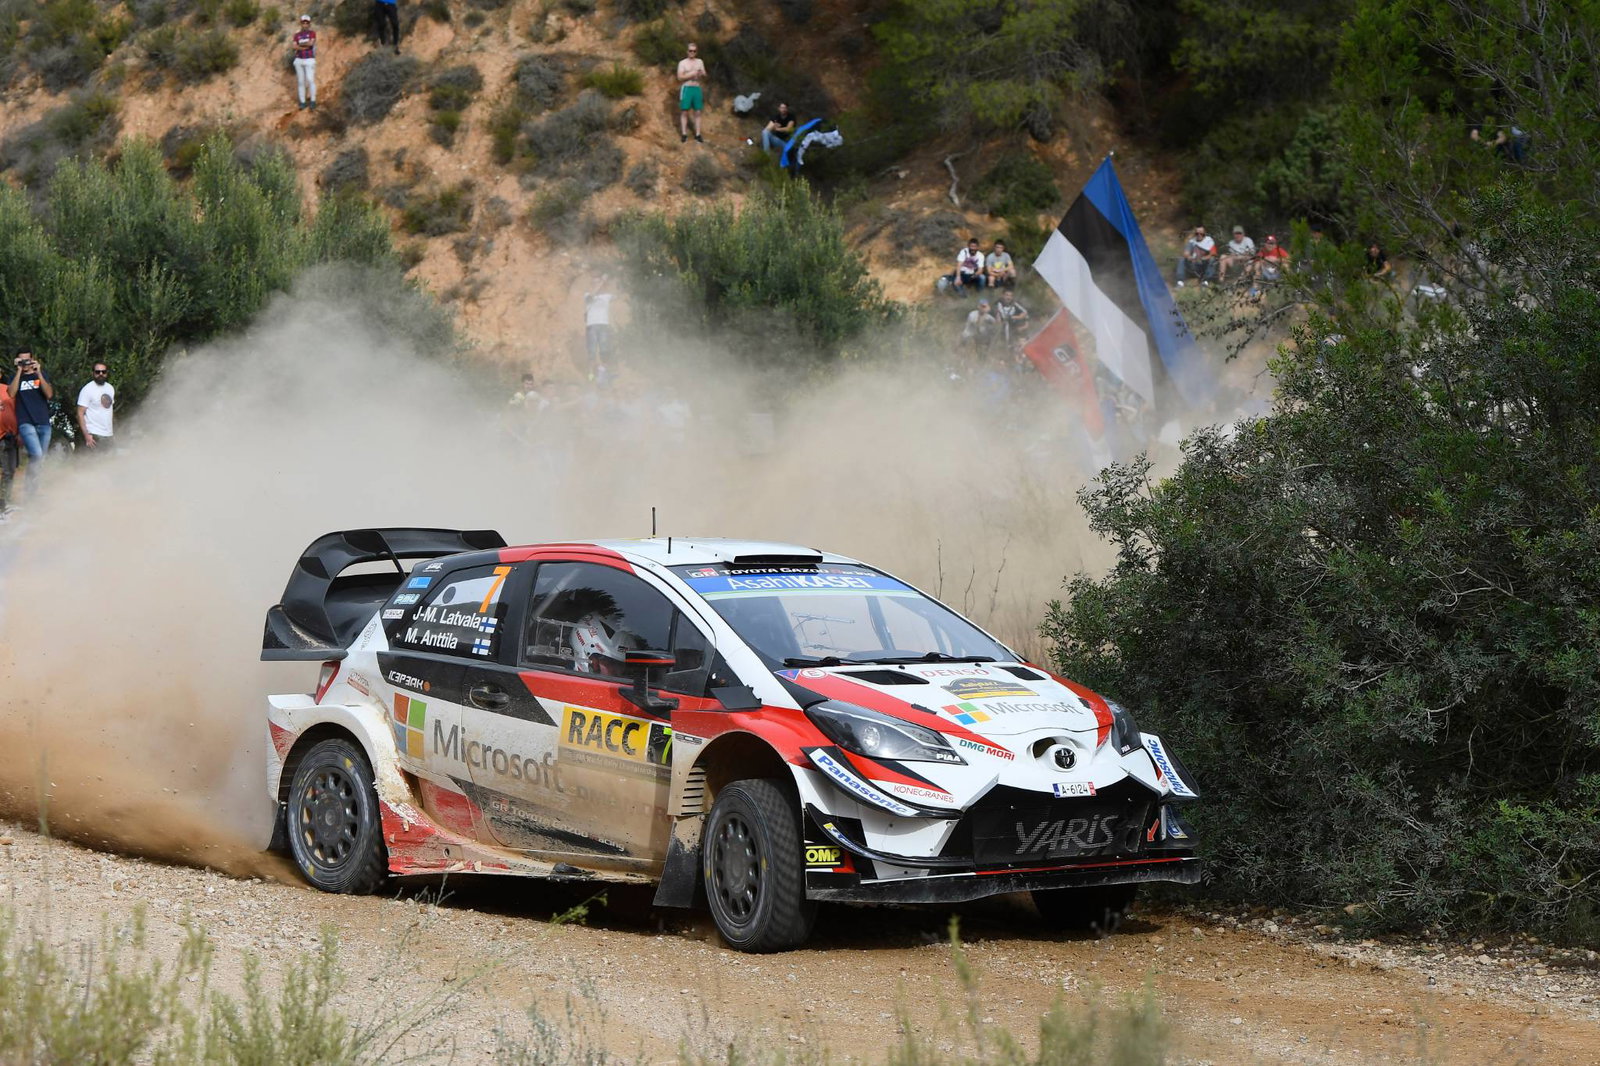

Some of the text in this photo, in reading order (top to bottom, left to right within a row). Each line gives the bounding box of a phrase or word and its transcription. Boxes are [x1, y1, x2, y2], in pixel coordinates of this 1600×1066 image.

[479, 566, 512, 613] 7
[412, 605, 437, 623] J-M.
[439, 608, 480, 629] Latvala
[404, 627, 458, 650] M. Anttila
[919, 669, 991, 678] DENSO
[982, 701, 1085, 716] Microsoft
[567, 710, 641, 756] RACC
[433, 718, 565, 793] Microsoft
[936, 753, 962, 763] PIAA
[958, 739, 1017, 761] DMG MORI
[1147, 738, 1187, 796] Panasonic
[816, 754, 909, 814] Panasonic
[893, 784, 956, 804] KONECRANES
[1060, 783, 1089, 796] A-6124
[805, 849, 842, 863] OMP
